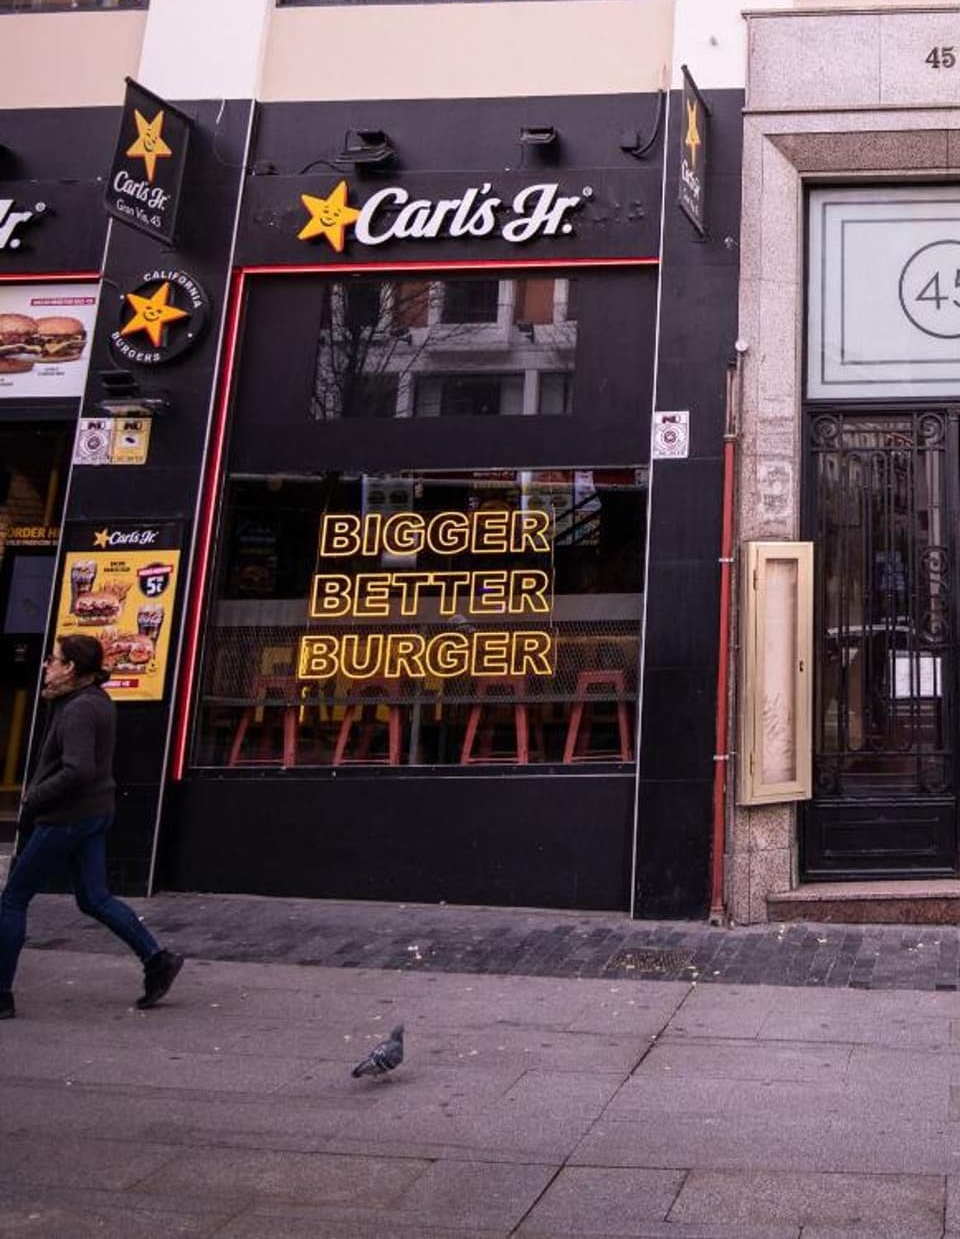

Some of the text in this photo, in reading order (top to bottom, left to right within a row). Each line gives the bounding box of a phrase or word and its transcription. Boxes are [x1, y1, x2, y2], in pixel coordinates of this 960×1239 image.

[925, 46, 956, 69] 45
[114, 171, 168, 210] Carl's Jr.
[150, 215, 161, 228] 45
[354, 182, 500, 246] Carl's
[143, 270, 202, 309] CALIFORNIA
[111, 331, 160, 362] BURGERS
[320, 511, 551, 557] BIGGER
[310, 569, 551, 618] BETTER
[297, 631, 554, 680] BURGER
